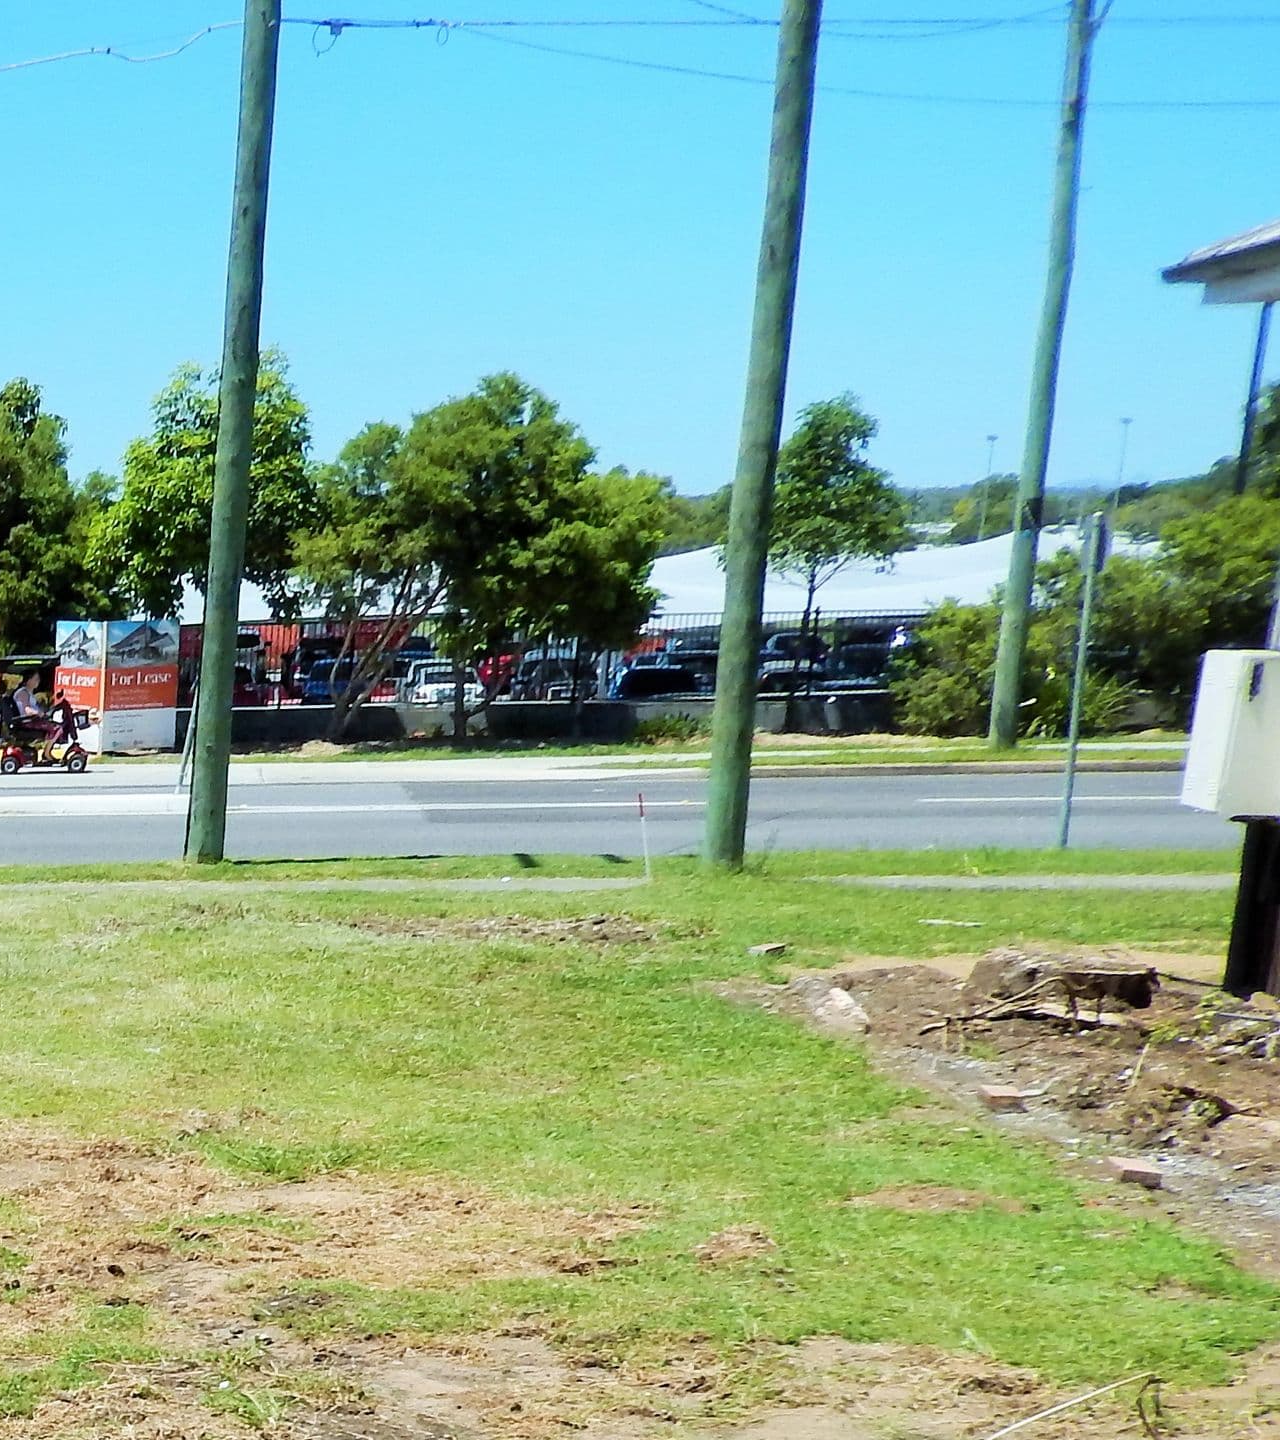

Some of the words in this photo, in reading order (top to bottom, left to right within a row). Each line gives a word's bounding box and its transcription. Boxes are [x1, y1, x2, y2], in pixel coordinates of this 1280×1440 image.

[57, 671, 69, 686] For
[71, 672, 97, 686] Lease
[111, 672, 135, 686] For
[137, 671, 172, 684] Lease
